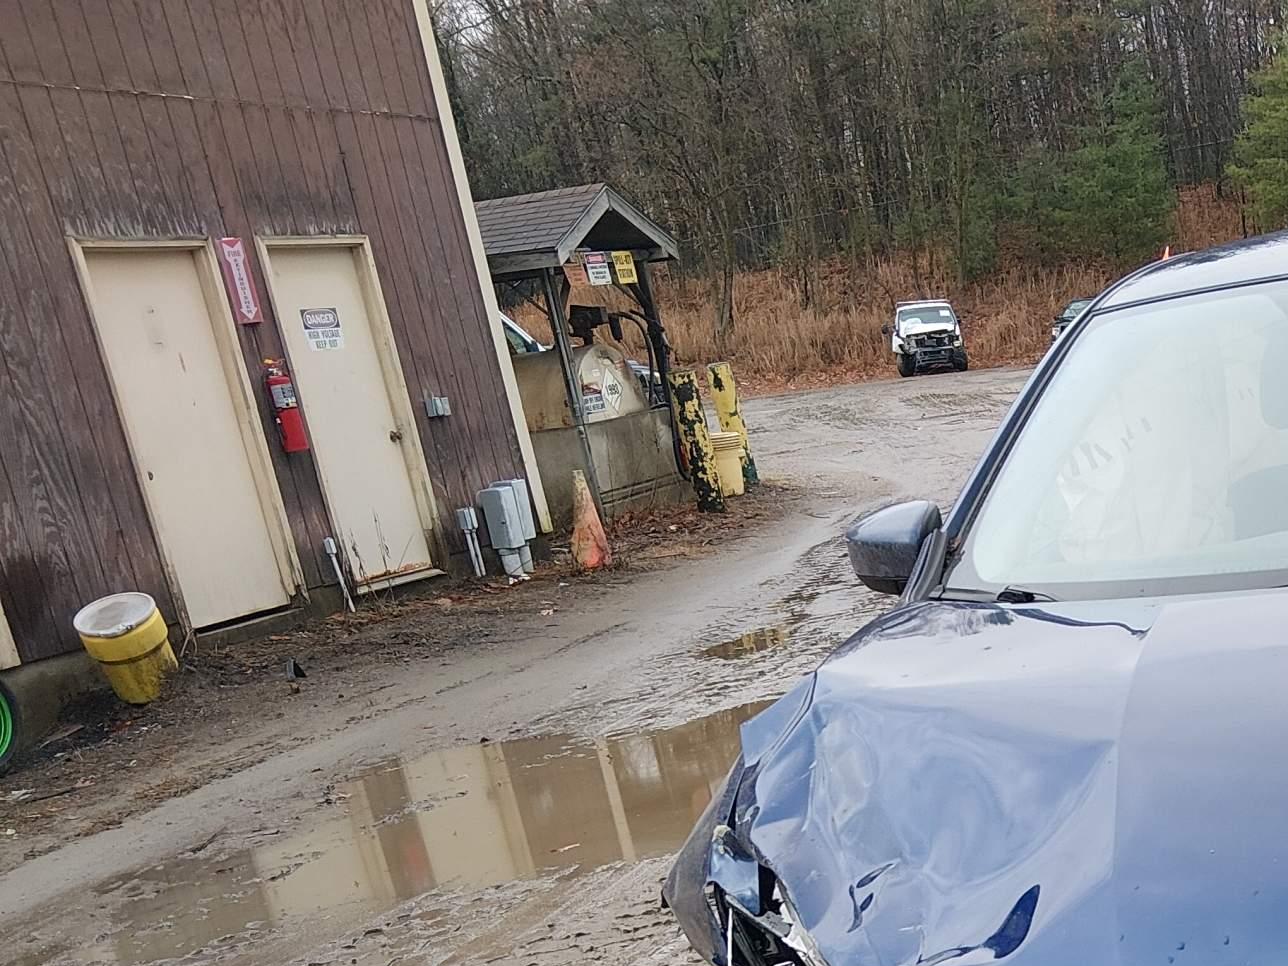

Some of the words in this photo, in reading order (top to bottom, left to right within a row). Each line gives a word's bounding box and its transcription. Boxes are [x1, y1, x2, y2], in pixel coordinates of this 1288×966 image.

[233, 258, 253, 314] EXTINGUISHER
[305, 313, 335, 325] DANGER
[308, 330, 320, 340] HIGH
